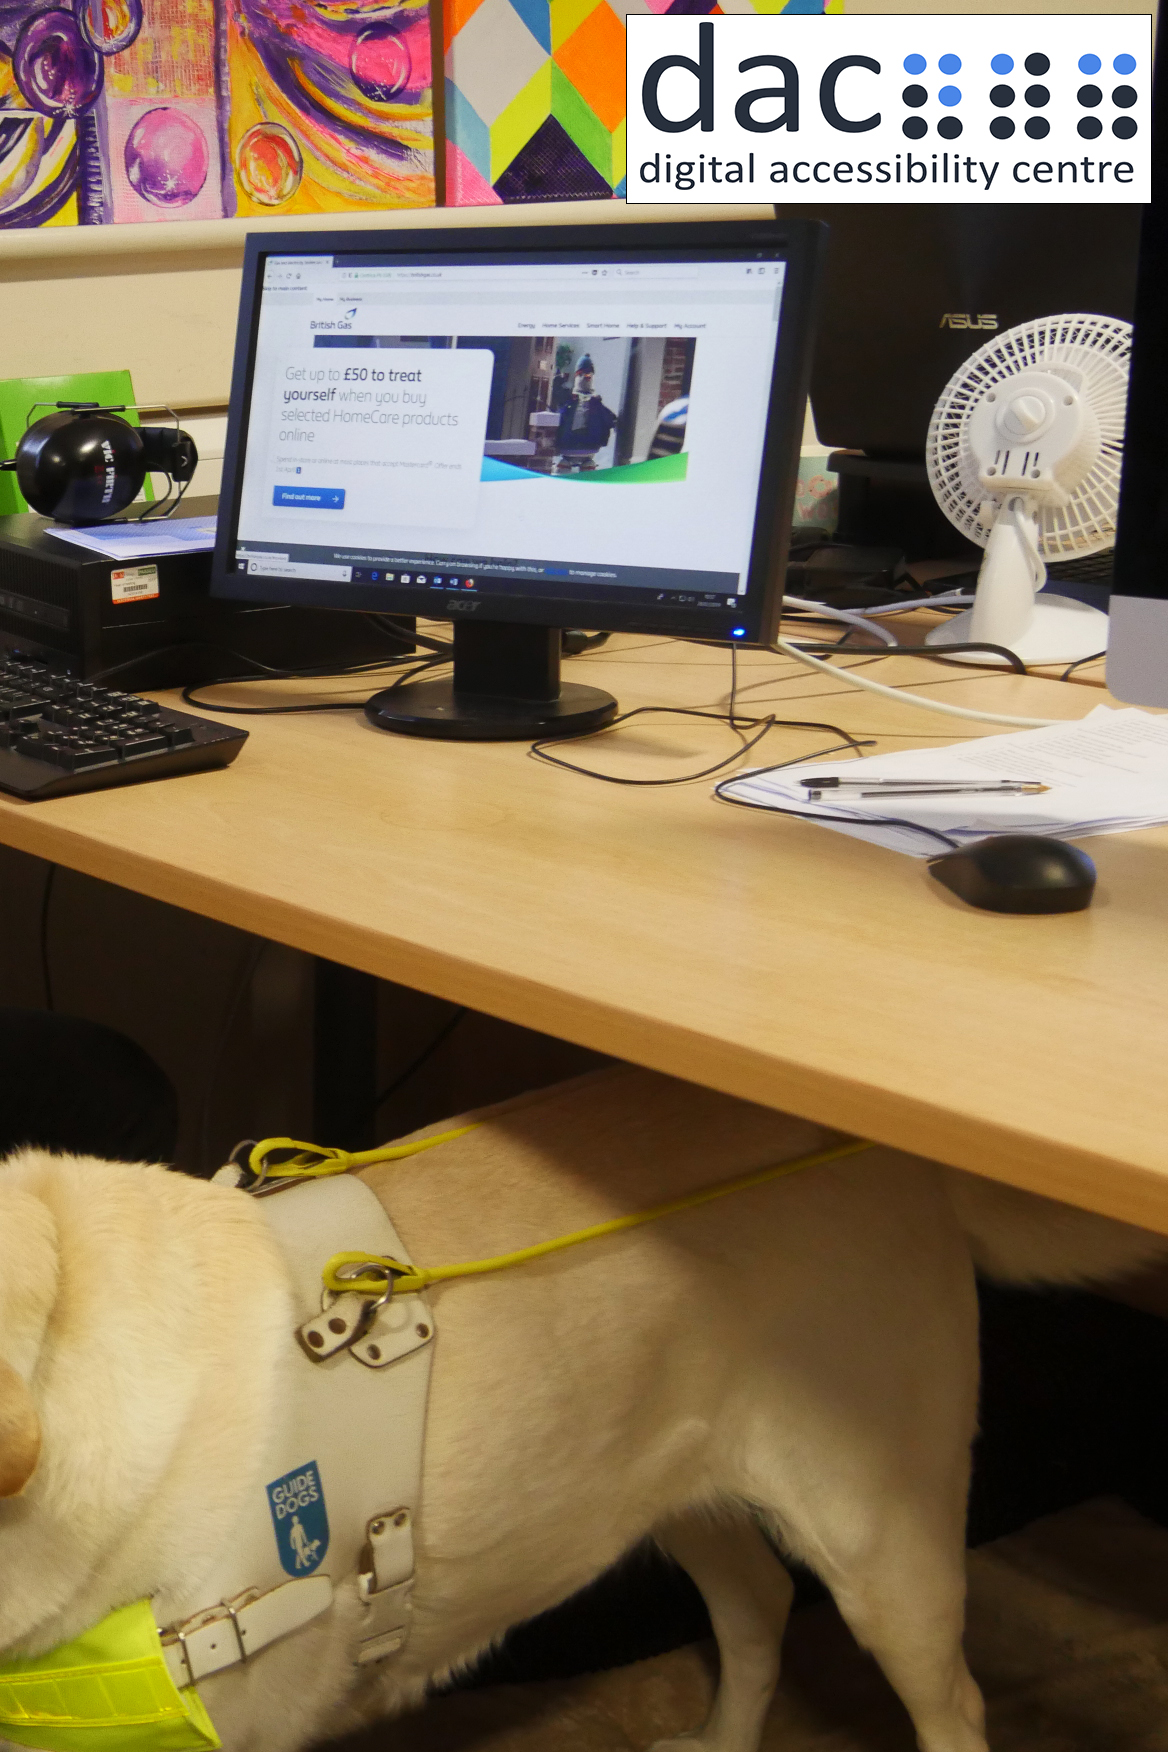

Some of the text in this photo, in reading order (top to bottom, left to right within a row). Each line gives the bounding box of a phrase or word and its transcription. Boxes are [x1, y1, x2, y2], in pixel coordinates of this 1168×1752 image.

[310, 320, 352, 329] British Gas
[939, 313, 999, 330] ASUS
[285, 366, 422, 384] Get up to £50 to treat
[283, 387, 427, 408] yourself when you buy
[281, 407, 459, 428] selected HomeCare products
[278, 428, 315, 442] online
[446, 599, 482, 612] acer
[272, 1470, 316, 1503] GUIDE
[276, 1486, 319, 1520] DOGS
